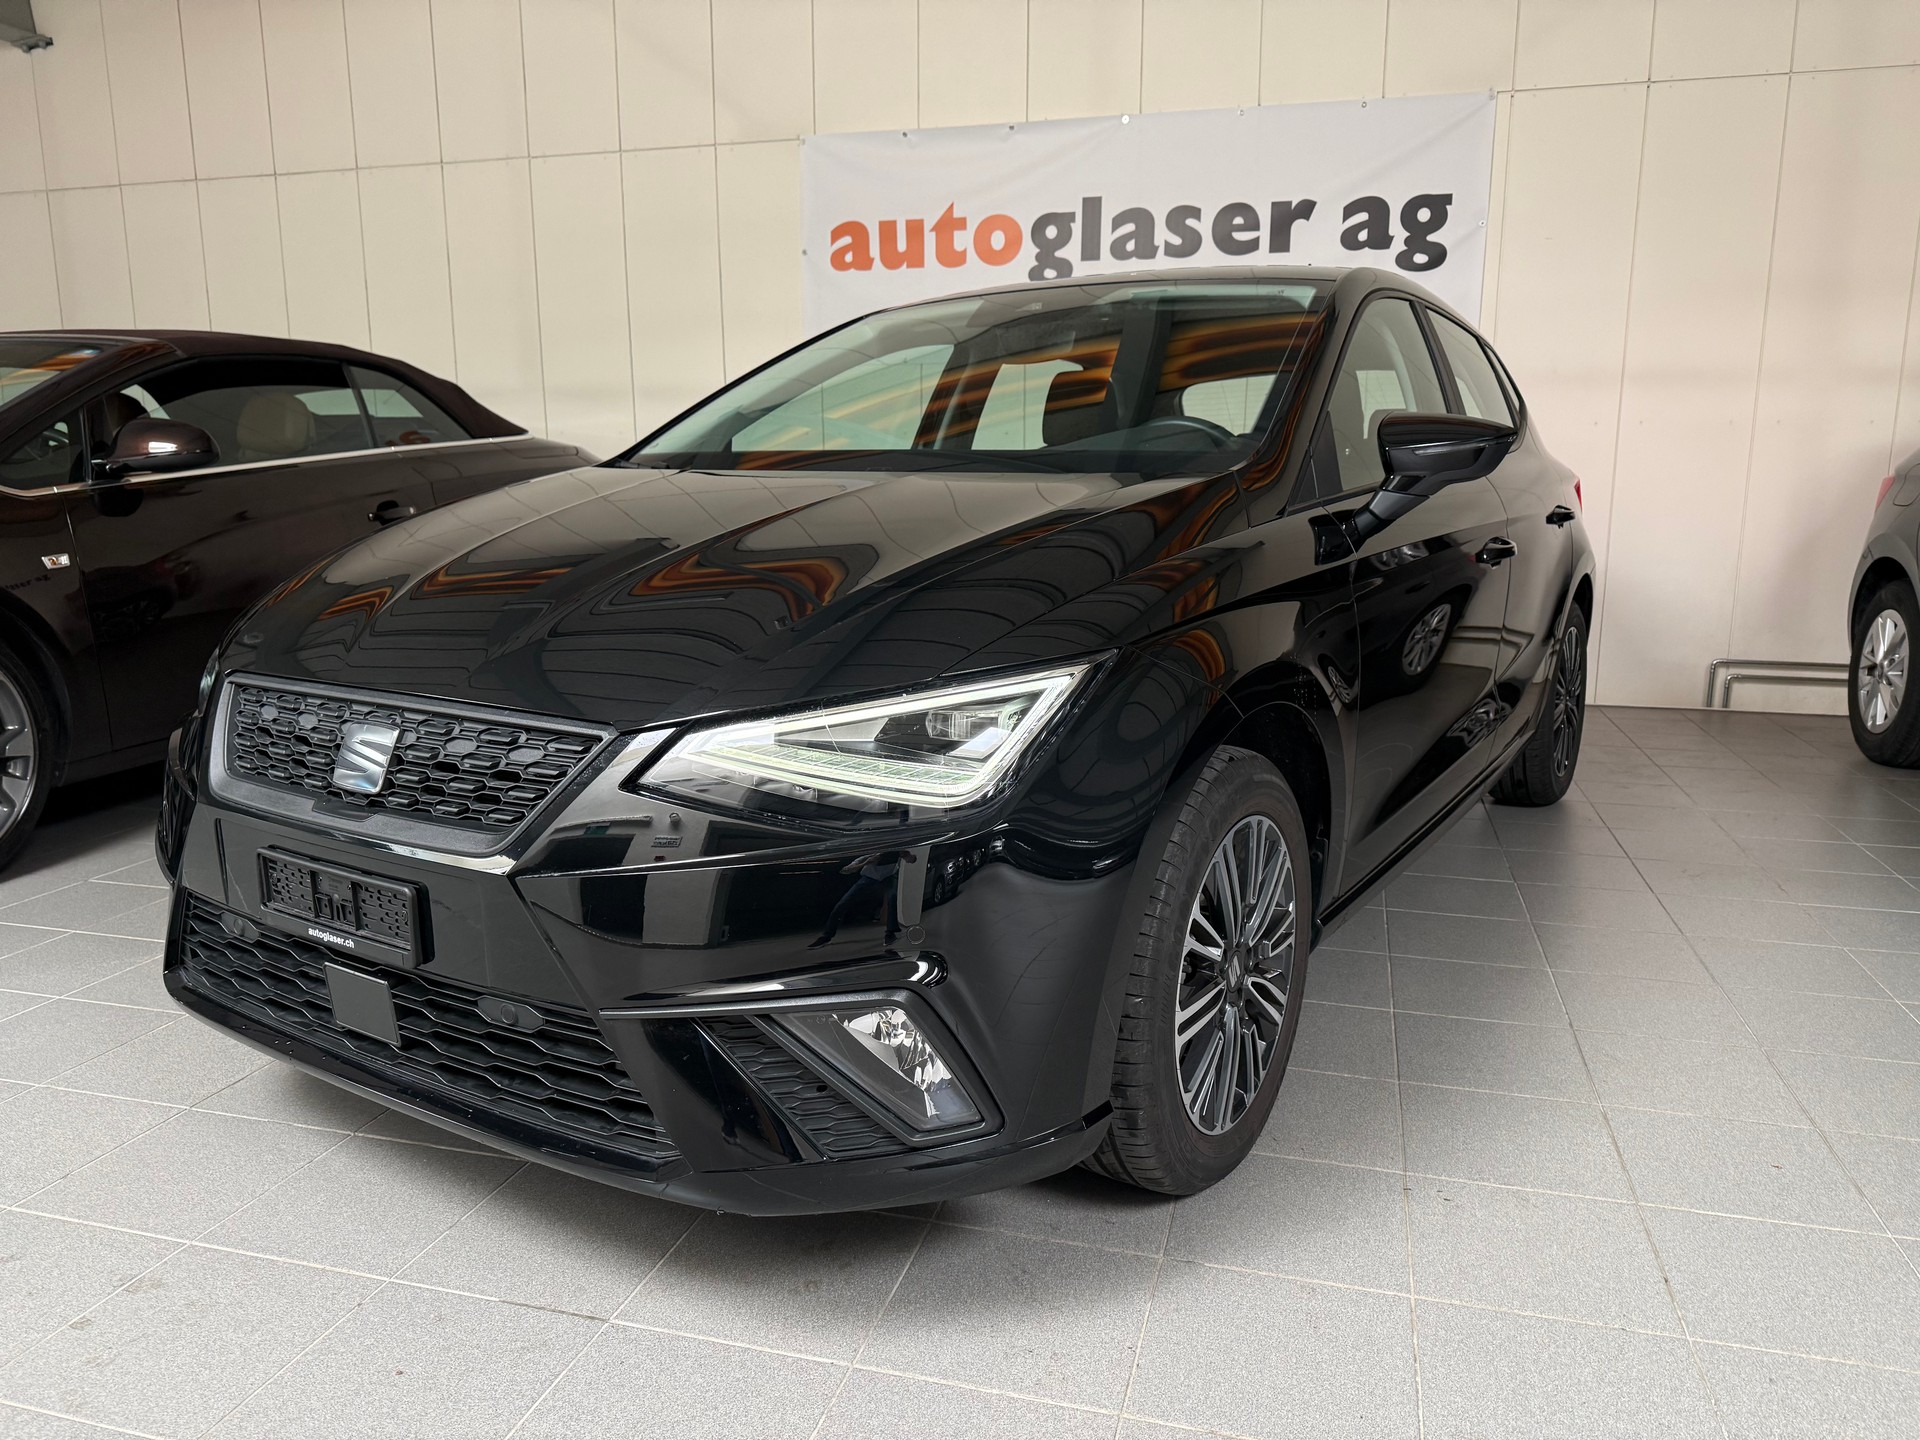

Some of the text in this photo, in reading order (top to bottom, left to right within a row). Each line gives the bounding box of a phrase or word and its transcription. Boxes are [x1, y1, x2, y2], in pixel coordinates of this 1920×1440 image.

[830, 193, 1454, 281] autoglaser ag
[308, 927, 355, 949] autoglaser.ch
